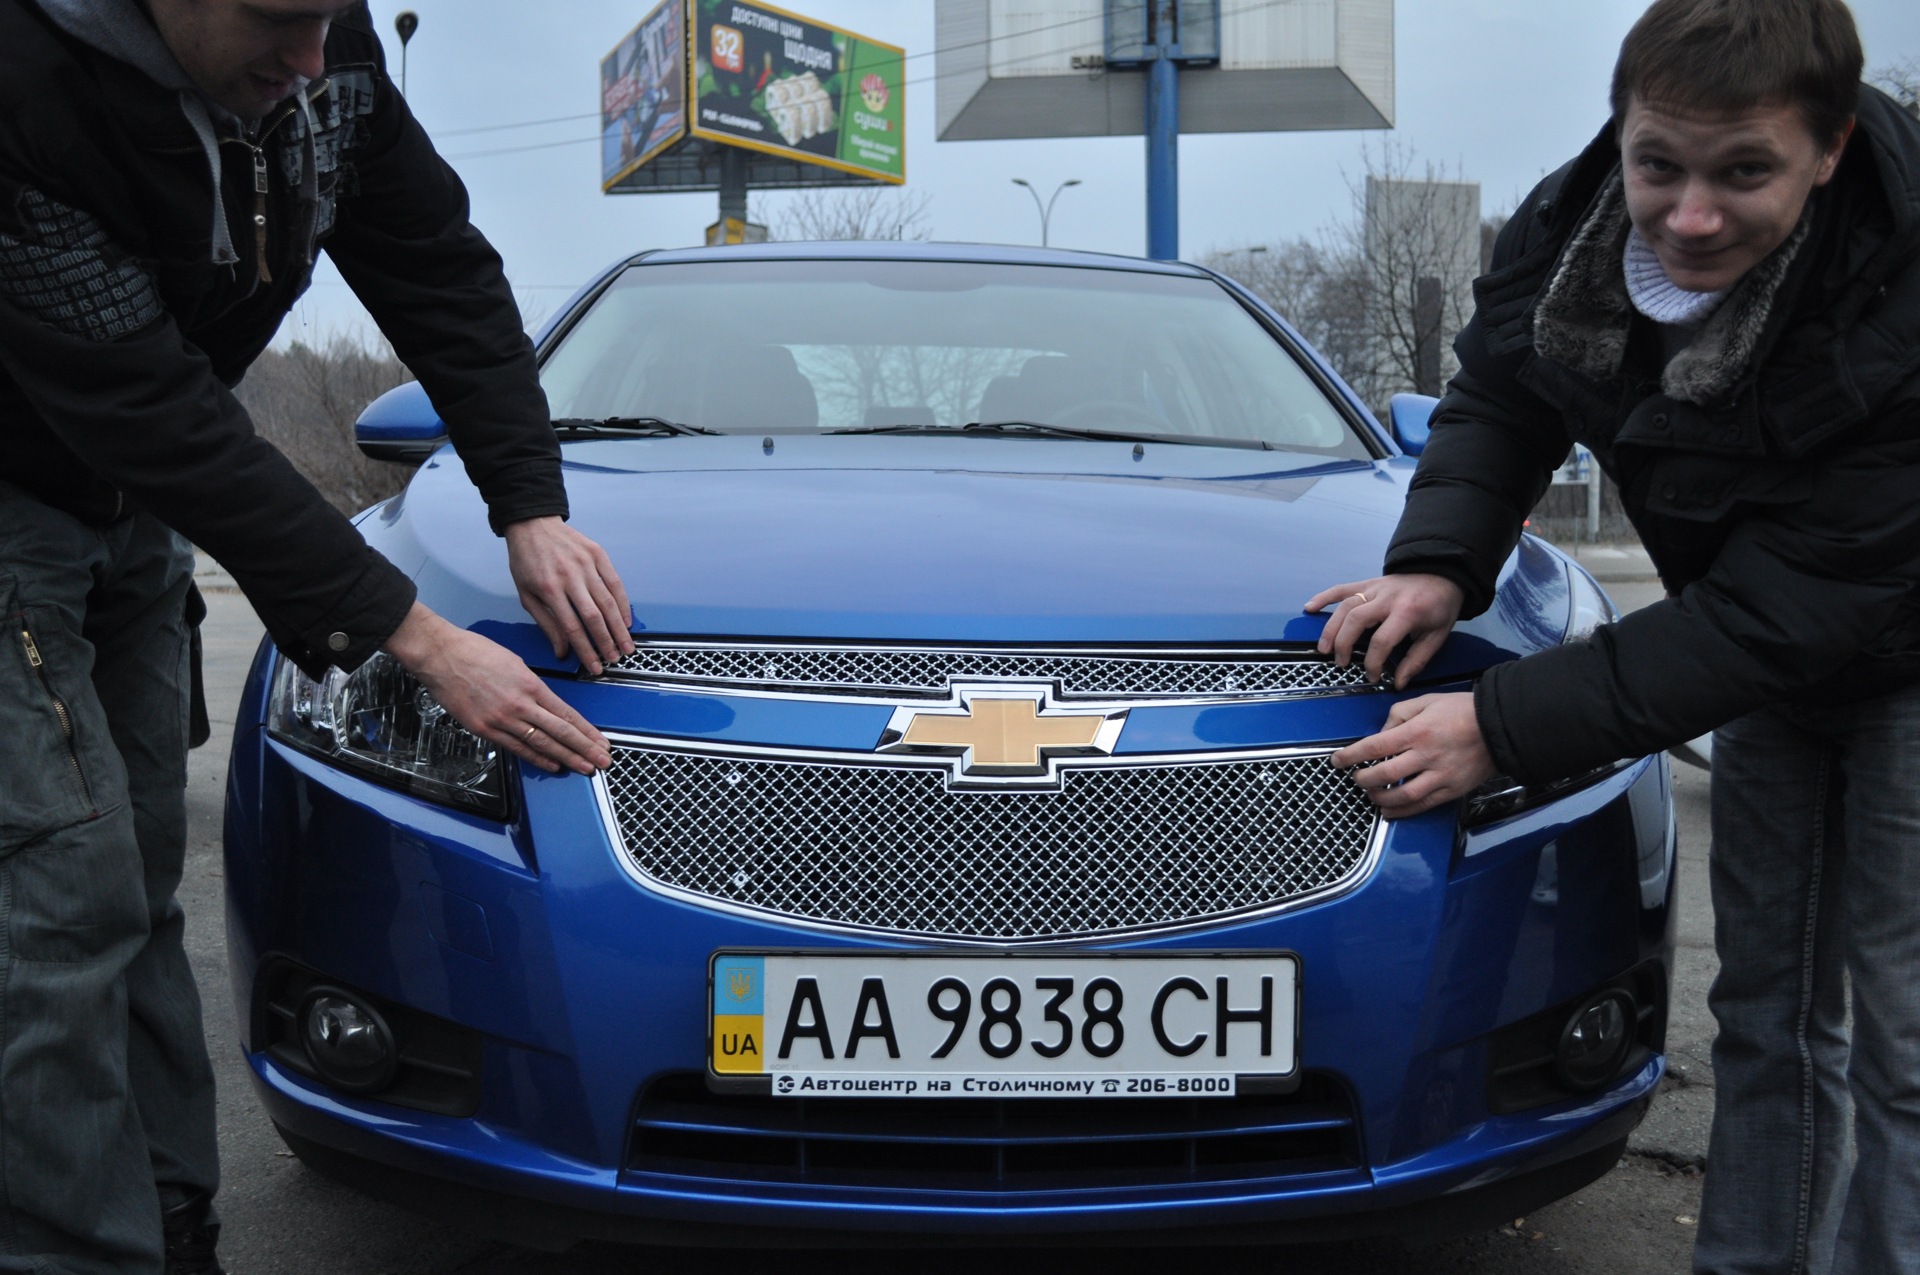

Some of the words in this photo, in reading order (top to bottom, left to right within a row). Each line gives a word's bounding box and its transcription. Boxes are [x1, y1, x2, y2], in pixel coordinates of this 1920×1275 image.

[715, 29, 739, 58] 32
[784, 39, 832, 70] ЩОДНЯ
[44, 259, 108, 289] GLAMOUR
[29, 287, 72, 307] THERE
[72, 284, 87, 298] IS
[87, 277, 106, 294] NO
[78, 299, 94, 313] IS
[94, 292, 112, 308] NO
[84, 315, 100, 329] IS
[100, 307, 119, 323] NO
[777, 976, 901, 1060] AA
[927, 976, 1125, 1060] 9838
[1150, 975, 1273, 1058] CH
[722, 1033, 758, 1056] UA
[799, 1076, 918, 1095] Автоцентр
[927, 1080, 952, 1092] на
[962, 1077, 1095, 1095] Столичному
[1126, 1077, 1230, 1093] 206-8000
